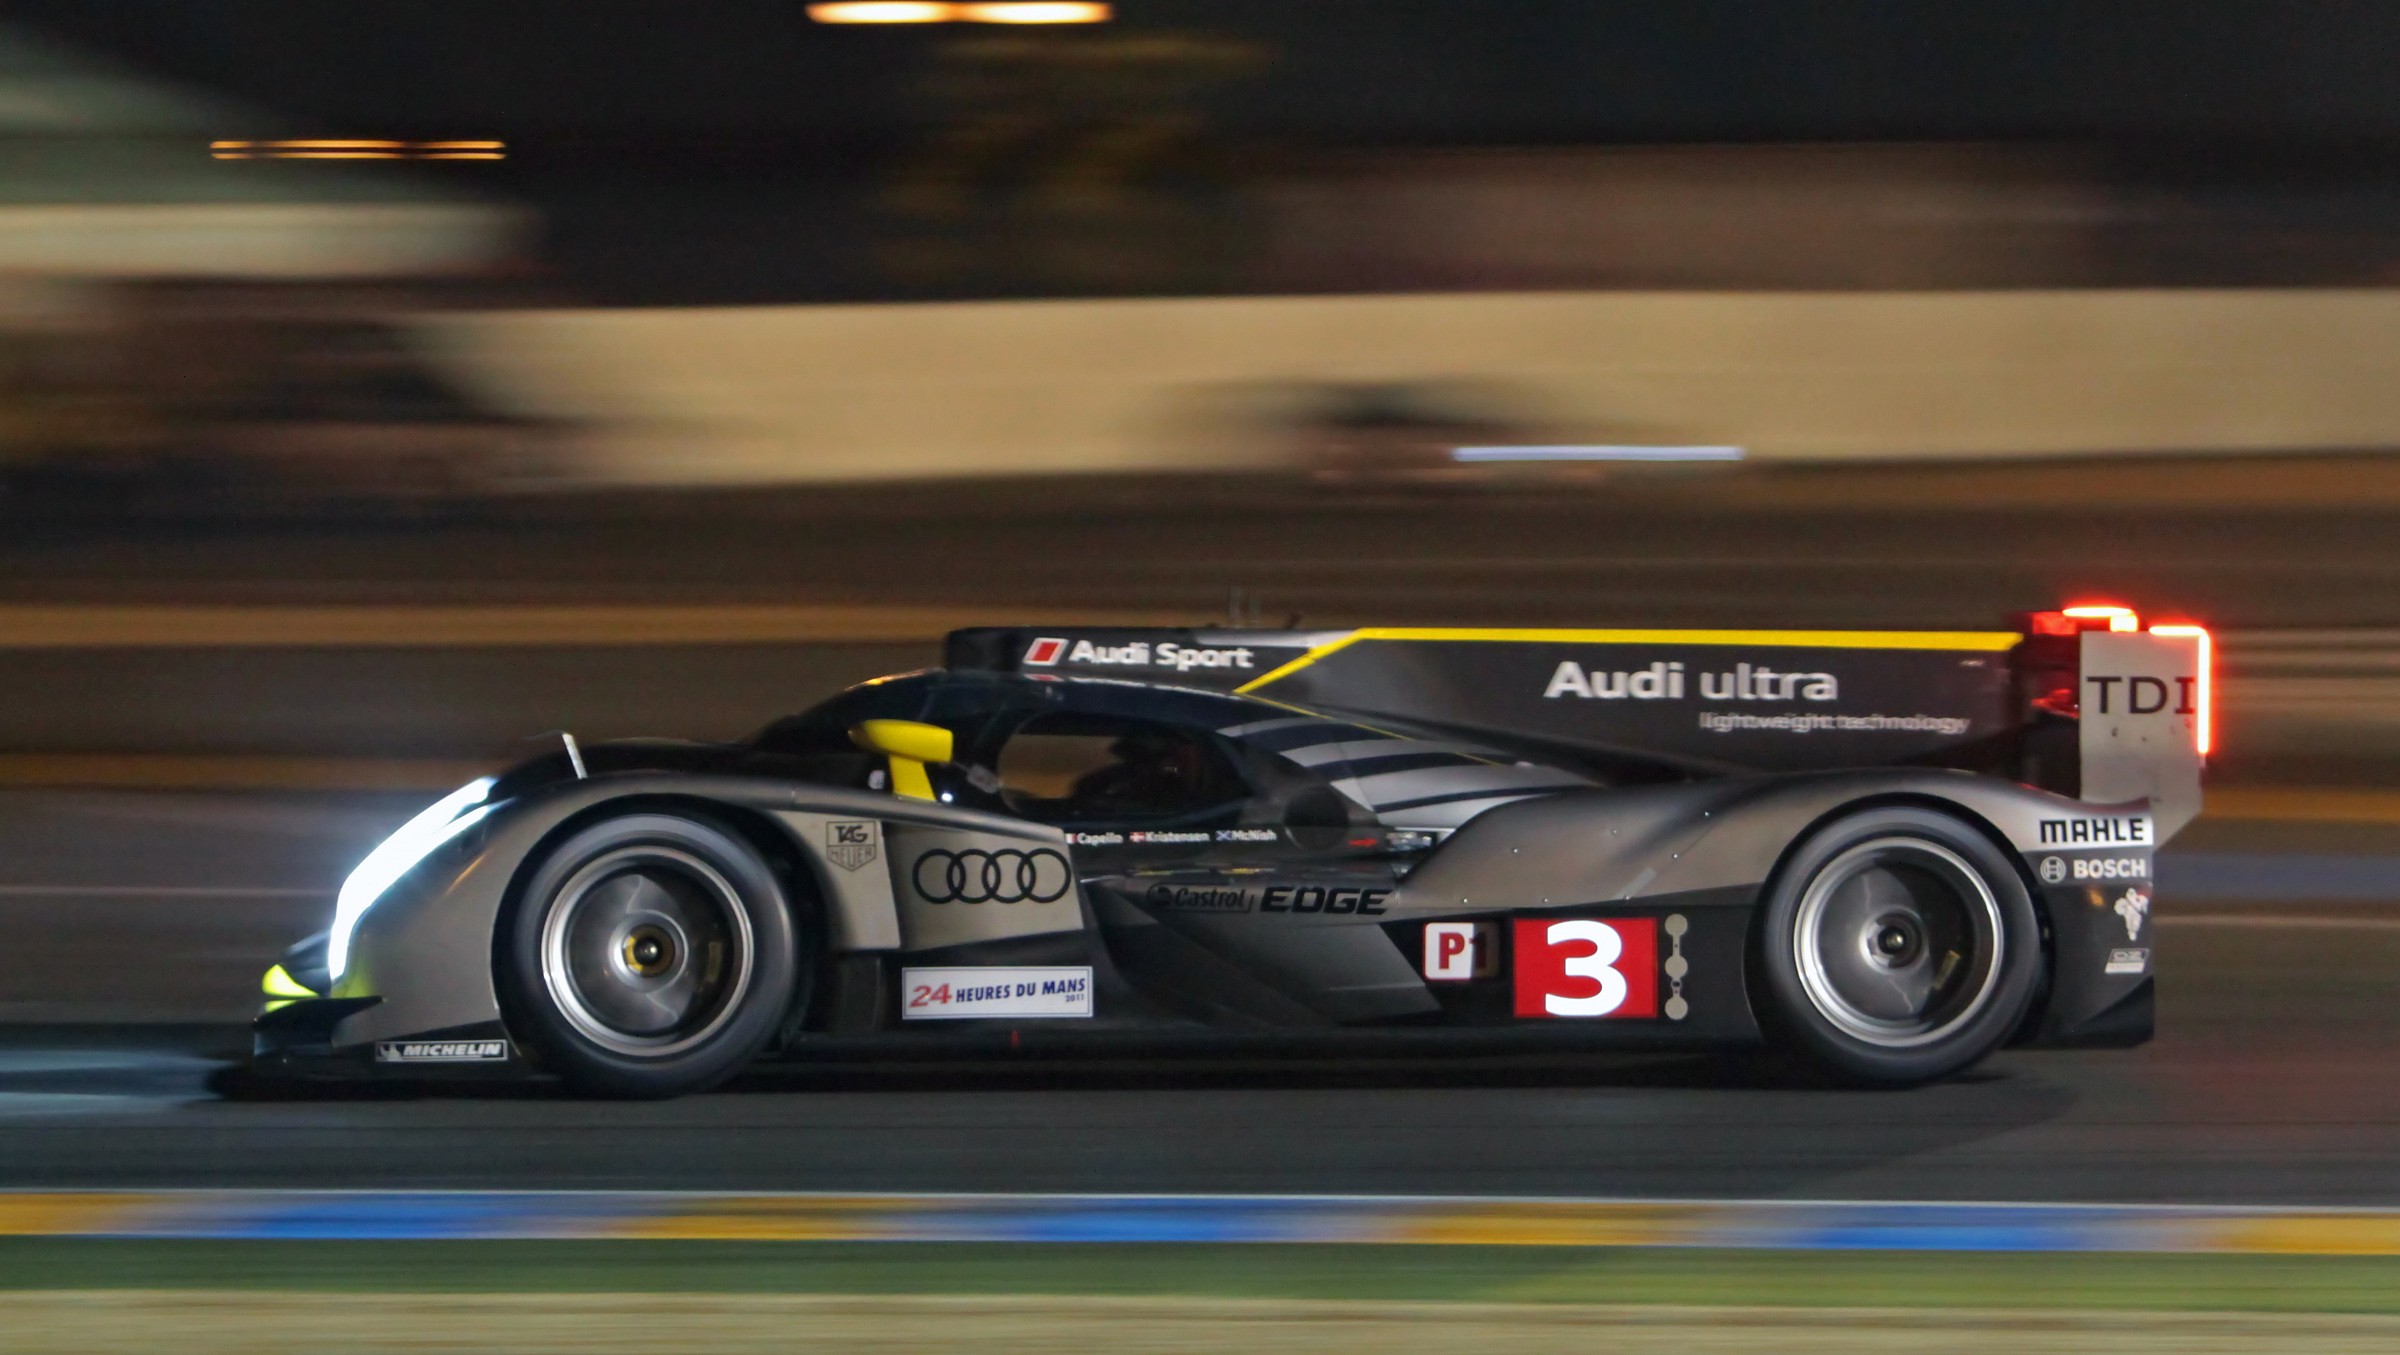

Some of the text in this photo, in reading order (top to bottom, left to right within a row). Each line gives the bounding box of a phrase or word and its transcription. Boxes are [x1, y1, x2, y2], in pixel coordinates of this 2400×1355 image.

[1068, 639, 1254, 671] Audi Sport
[1543, 660, 1839, 700] Audi ultra
[2086, 675, 2196, 715] TDI
[1699, 711, 1971, 735] lightweight technology
[834, 825, 869, 843] TAG
[1077, 829, 1277, 846] Capello Kristensen McNish
[2040, 817, 2144, 844] MAHLE
[2073, 858, 2147, 879] BOSCH
[1174, 886, 1394, 915] Castrol EDGE
[1438, 931, 1488, 971] P1
[1545, 919, 1628, 1017] 3
[909, 977, 1086, 1008] 24 HEURES DU MANS
[1065, 993, 1085, 1003] 2011
[403, 1043, 502, 1056] MICHELIN
